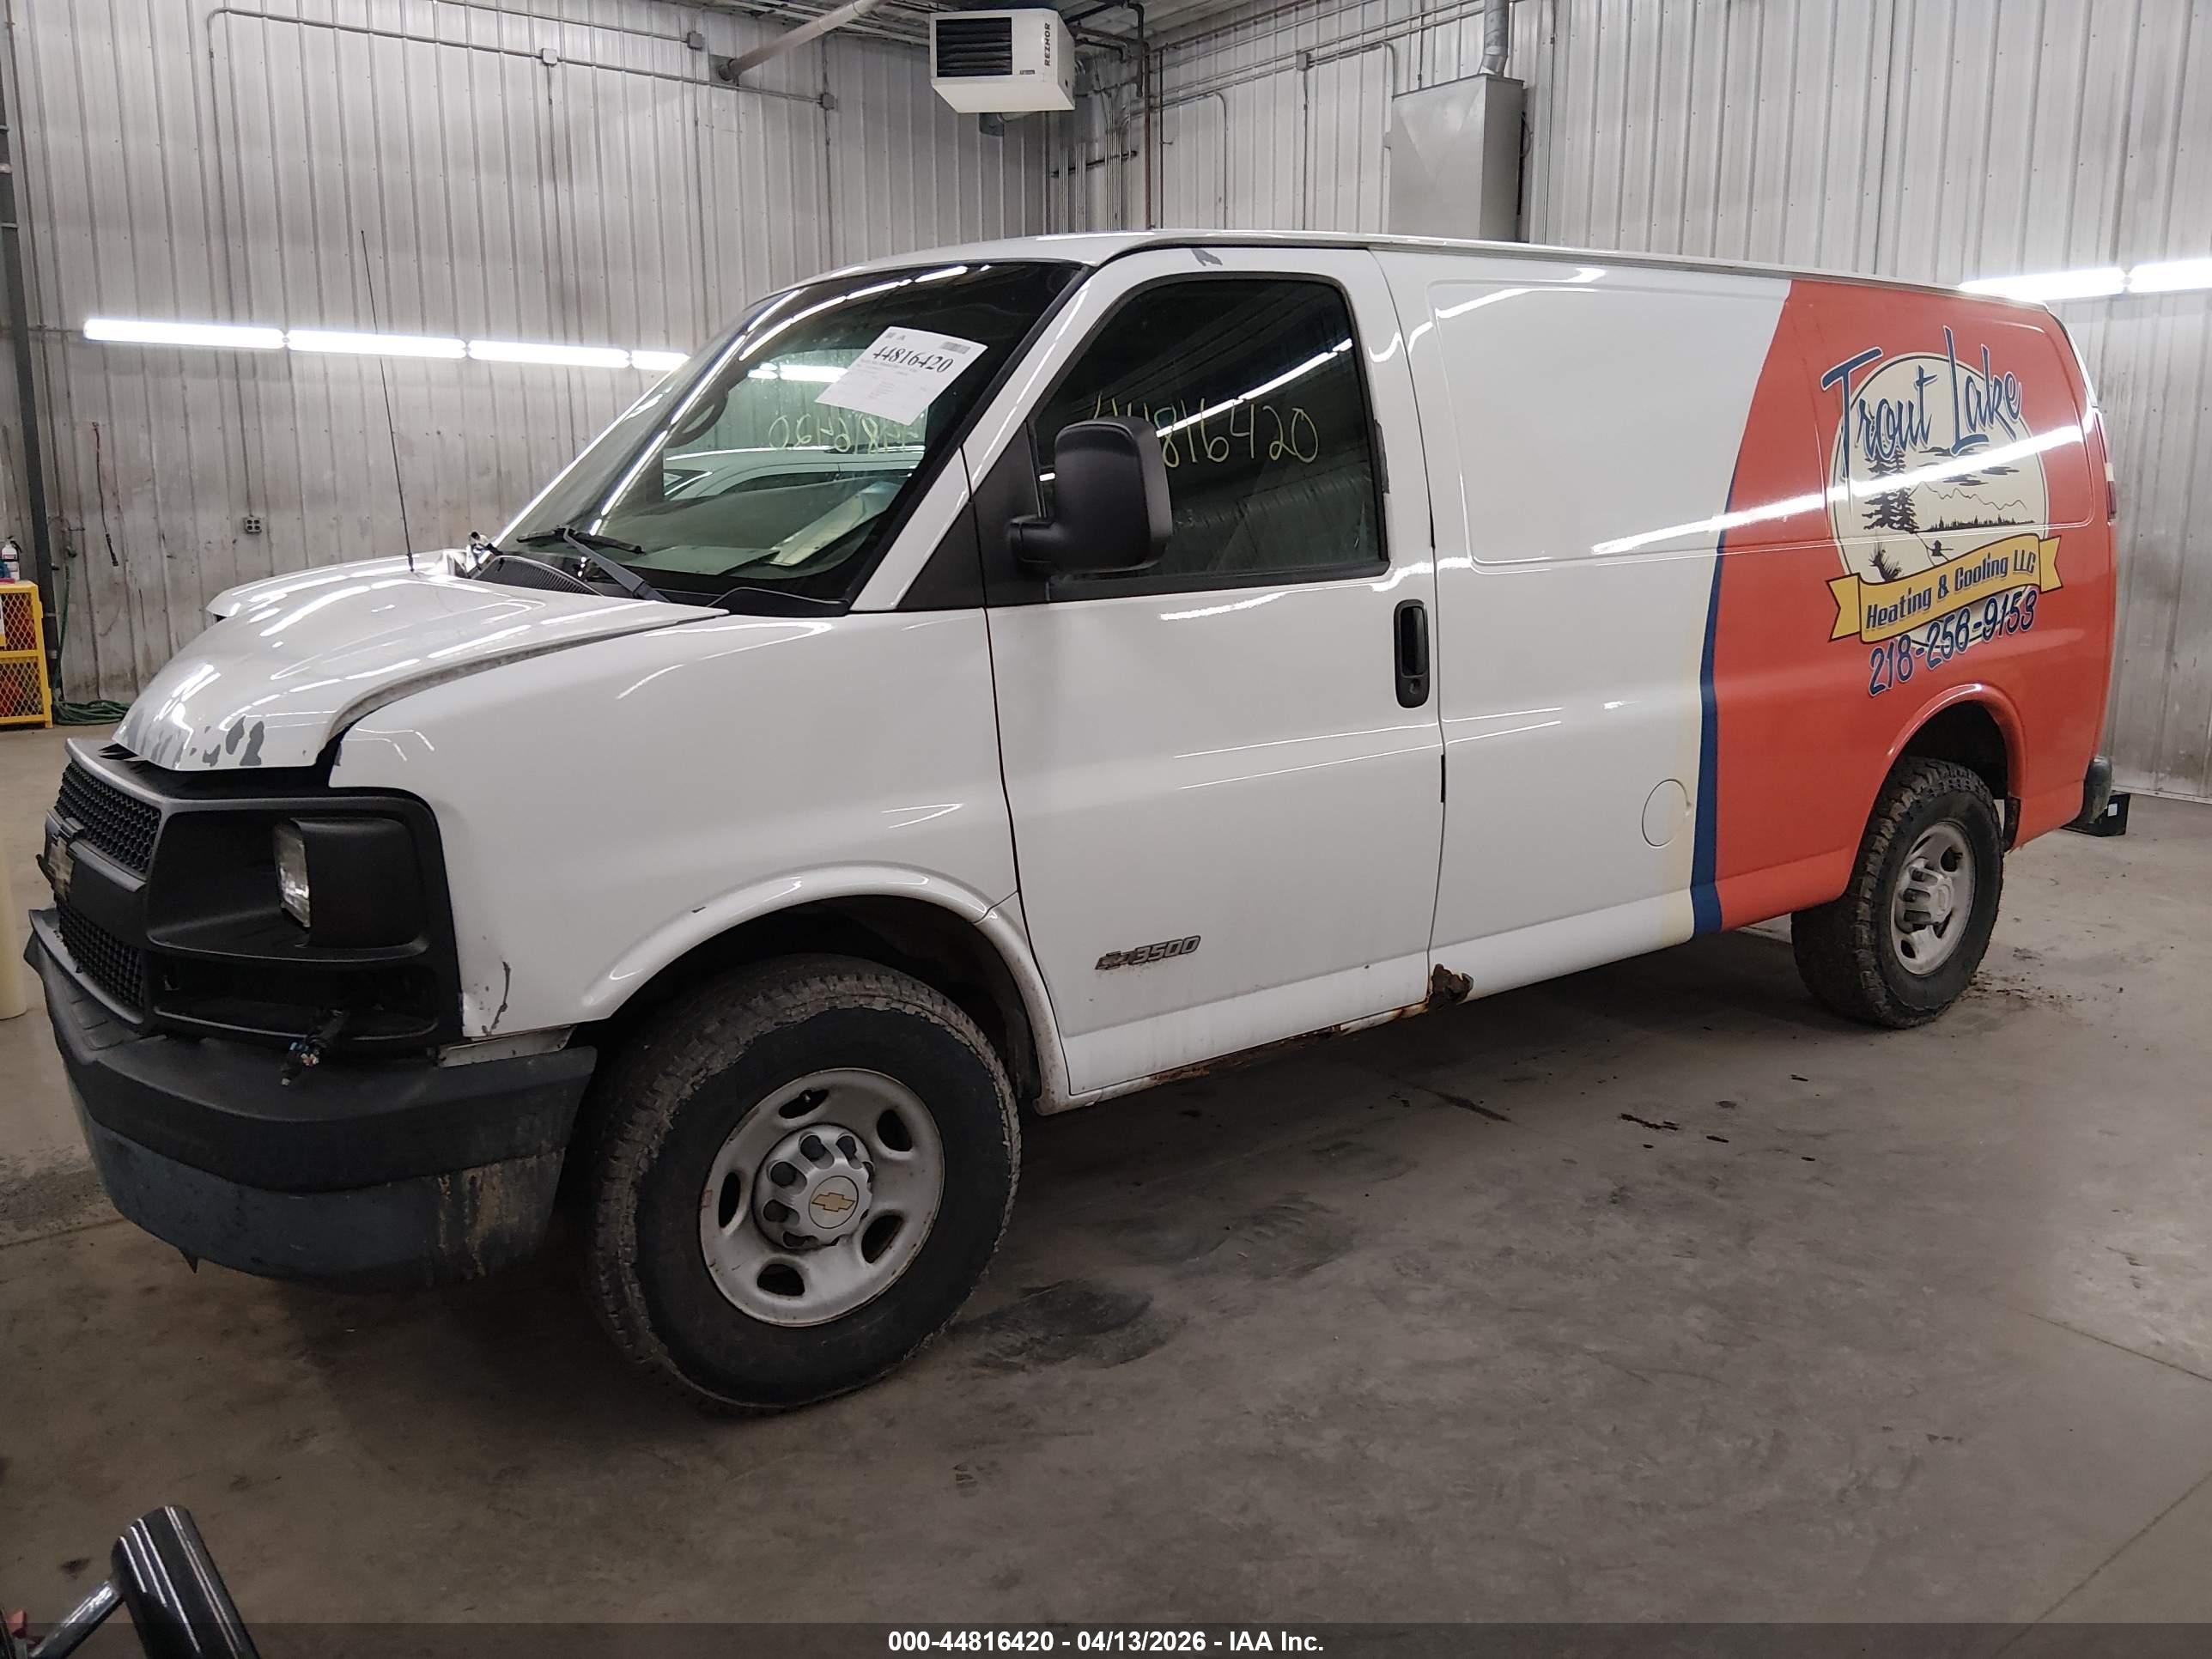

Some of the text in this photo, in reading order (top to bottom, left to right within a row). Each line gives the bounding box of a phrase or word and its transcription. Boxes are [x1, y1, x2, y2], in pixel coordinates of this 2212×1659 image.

[872, 345, 954, 373] 44816420
[1821, 325, 2023, 480] Trout Lake
[1865, 549, 2037, 630] Heating & Cooling LLC
[1129, 935, 1201, 965] 3500
